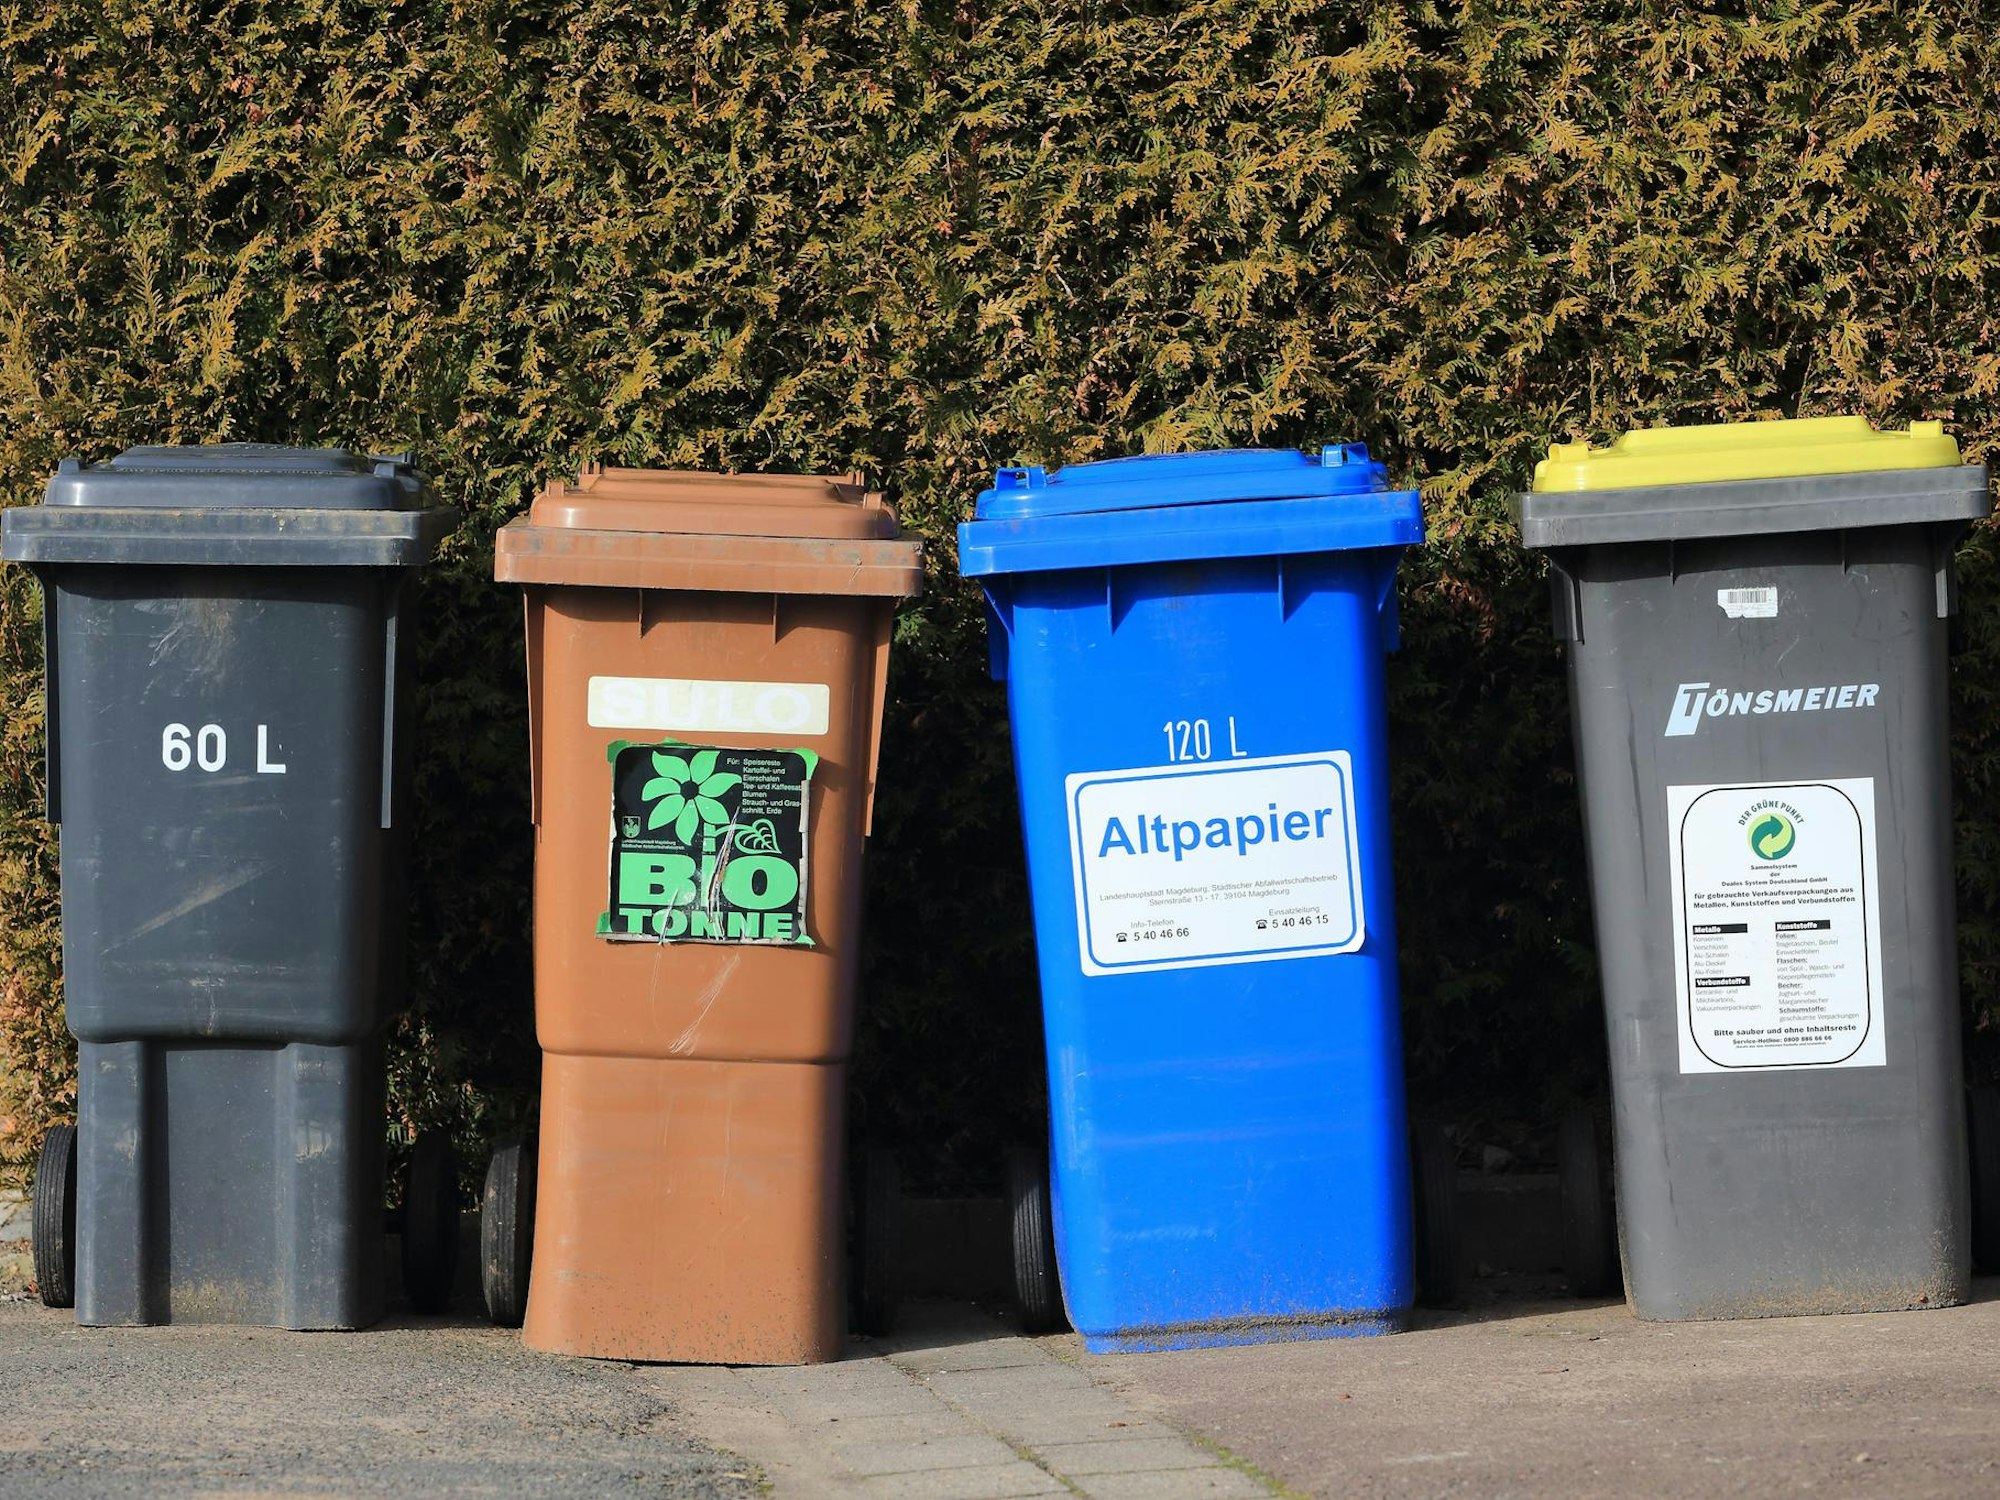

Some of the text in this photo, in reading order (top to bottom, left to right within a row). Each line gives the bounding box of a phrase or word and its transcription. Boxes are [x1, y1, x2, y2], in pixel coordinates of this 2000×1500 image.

[600, 680, 811, 730] SULO
[1664, 682, 1880, 737] TÖNSMEIER
[1163, 716, 1248, 761] 120 L
[162, 723, 286, 774] 60 L
[743, 758, 781, 767] Speisereste
[766, 807, 782, 815] Erde
[1738, 799, 1805, 826] DER GRÜNE PUNKT
[1098, 803, 1333, 862] Altpapier
[1254, 874, 1338, 888] Abfallwirtschaftsbetrieb
[1248, 888, 1290, 898] Magdeburg
[1707, 891, 1750, 900] gebrauchte
[1752, 888, 1838, 897] Verkaufsverpackungen
[1731, 899, 1780, 907] Kunststoffen
[1797, 896, 1856, 904] Verbundstoffen
[1268, 906, 1320, 916] Einsatzleitung
[619, 908, 793, 938] TONNE
[1130, 918, 1174, 929] Info-Telefon
[1272, 914, 1328, 928] 5 40 46 15
[1776, 922, 1817, 930] Kunststoffe
[1134, 927, 1189, 941] 5 40 46 66
[1807, 1025, 1857, 1033] Inhaltsreste
